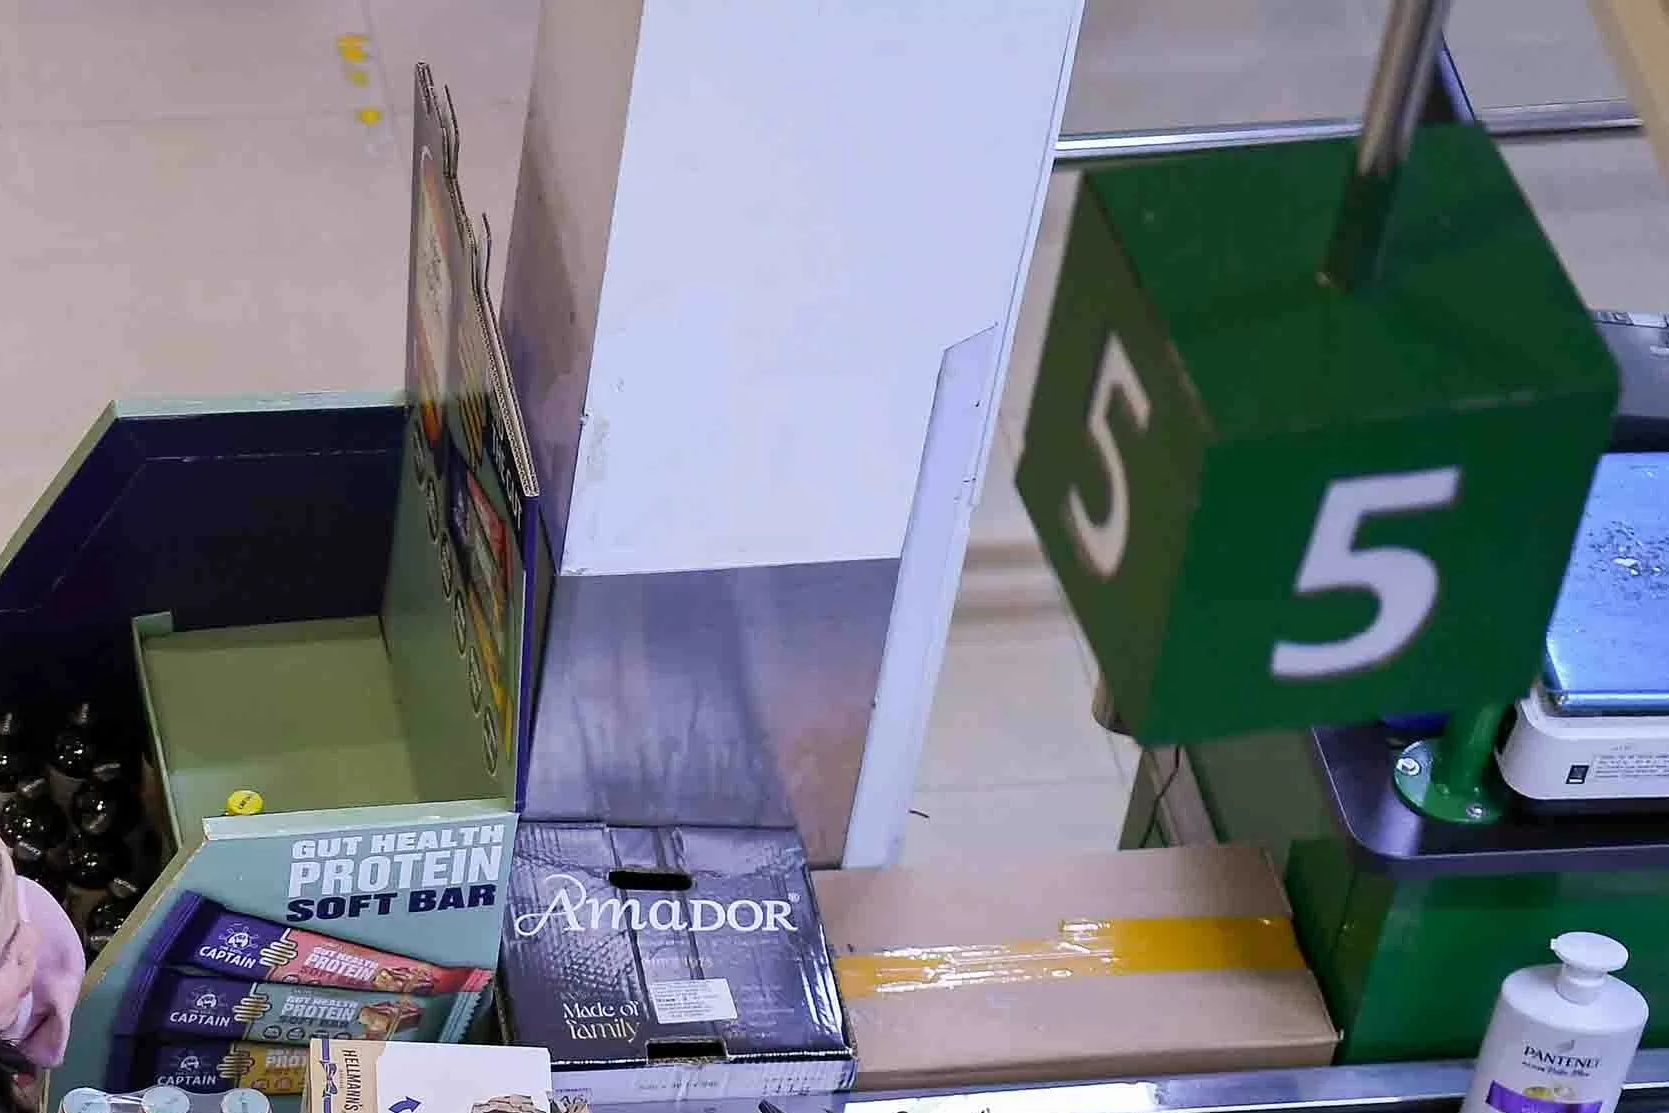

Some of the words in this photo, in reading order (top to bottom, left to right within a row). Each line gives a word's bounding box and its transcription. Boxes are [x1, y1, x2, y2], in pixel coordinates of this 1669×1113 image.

[1270, 465, 1462, 678] 5
[292, 837, 362, 859] GUT
[370, 824, 505, 853] HEALTH
[288, 846, 503, 898] PROTEIN
[287, 893, 398, 922] SOFT
[409, 884, 497, 912] BAR
[199, 946, 257, 969] CAPTAIN
[305, 956, 378, 981] PROTEIN
[170, 1012, 231, 1027] CAPTAIN
[282, 1004, 356, 1021] PROTEIN
[563, 1002, 615, 1019] Made
[620, 1001, 639, 1017] of
[566, 1020, 641, 1042] family
[157, 1075, 217, 1087] CAPTAIN
